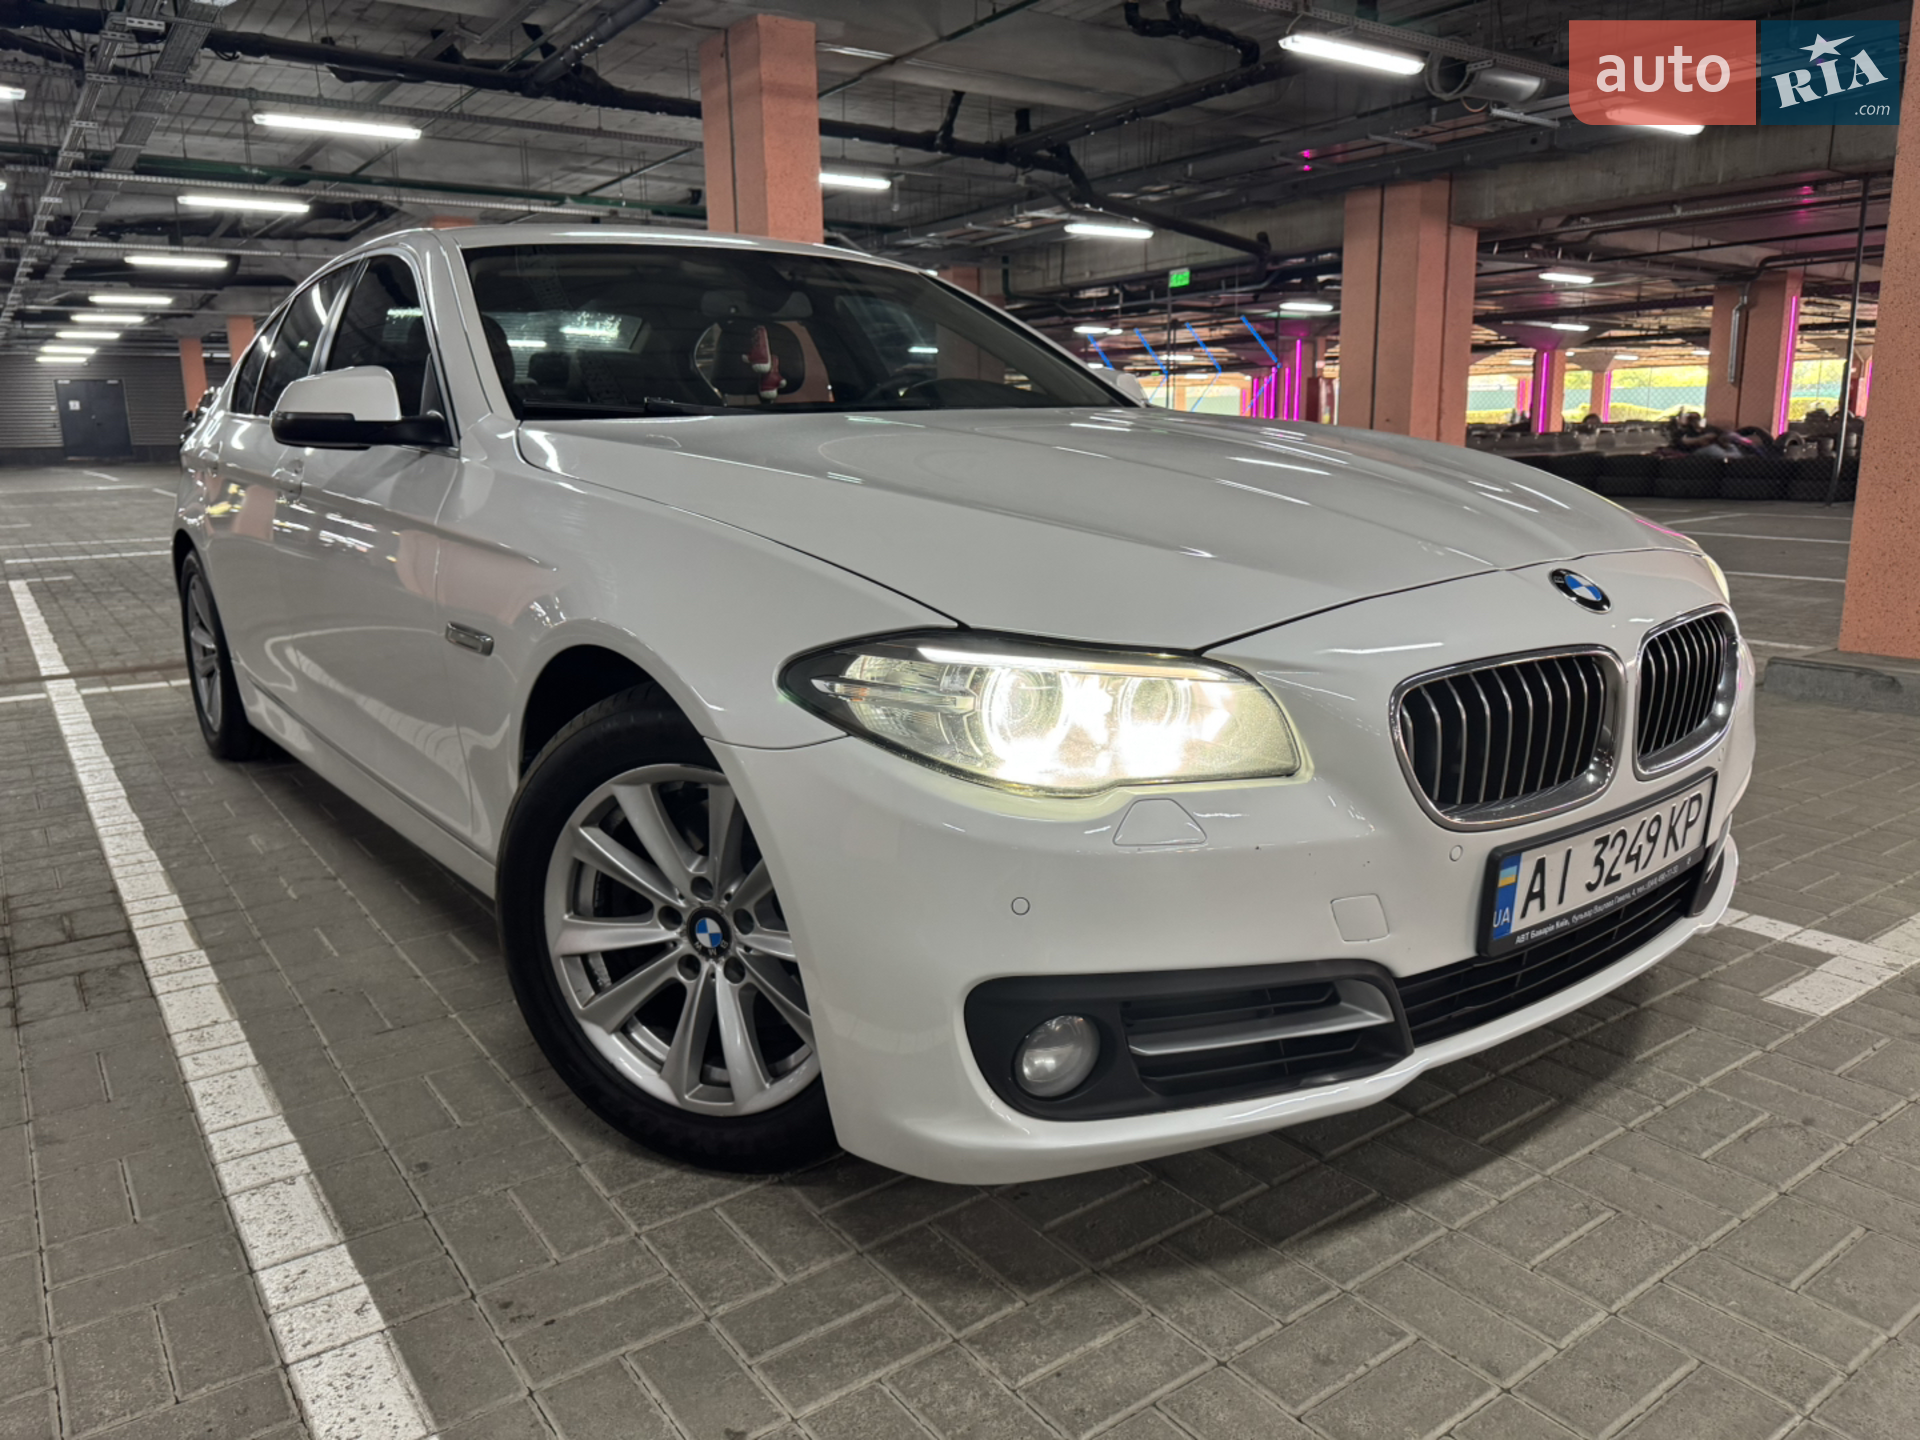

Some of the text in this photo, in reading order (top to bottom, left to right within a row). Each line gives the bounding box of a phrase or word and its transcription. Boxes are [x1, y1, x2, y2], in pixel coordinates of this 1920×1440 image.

[1520, 792, 1703, 919] AI 3249 KP
[1493, 907, 1510, 928] UA
